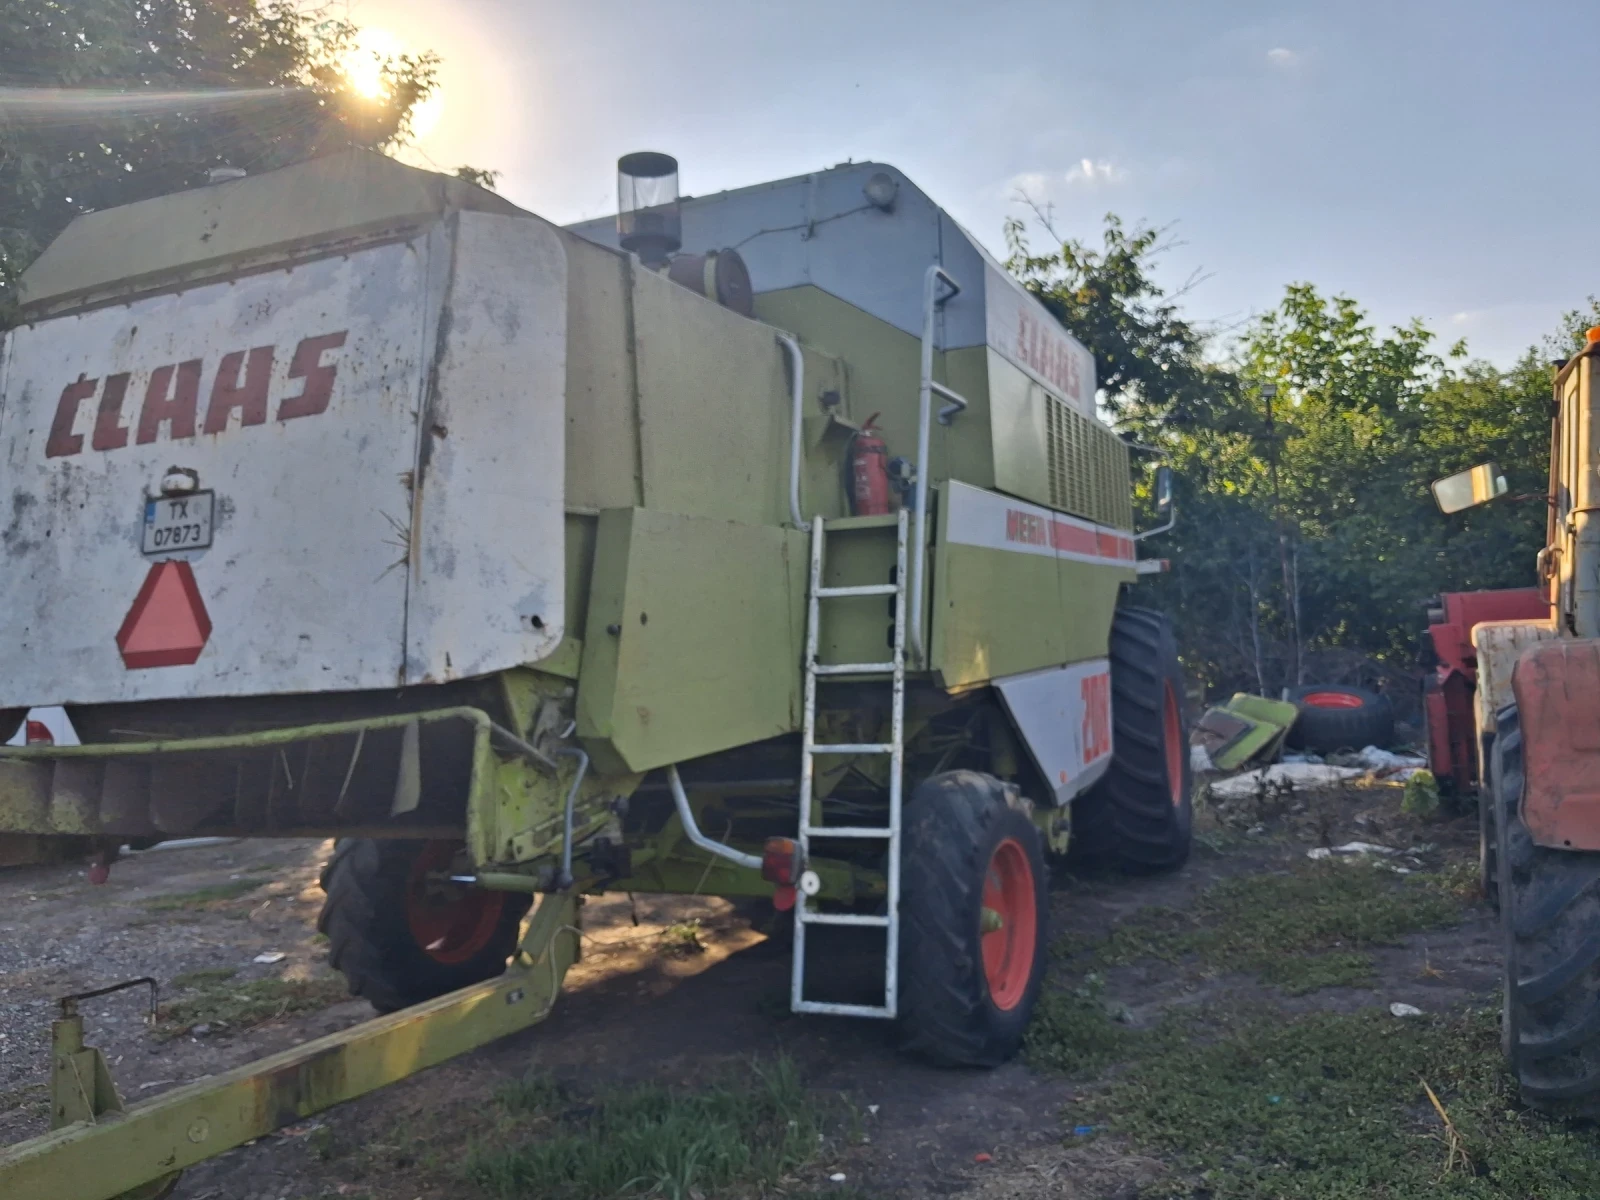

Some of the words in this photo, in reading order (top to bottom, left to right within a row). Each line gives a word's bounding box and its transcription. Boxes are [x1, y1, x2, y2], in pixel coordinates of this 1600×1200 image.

[45, 330, 348, 458] CLAAS
[169, 501, 188, 520] TX
[154, 524, 201, 546] 07873
